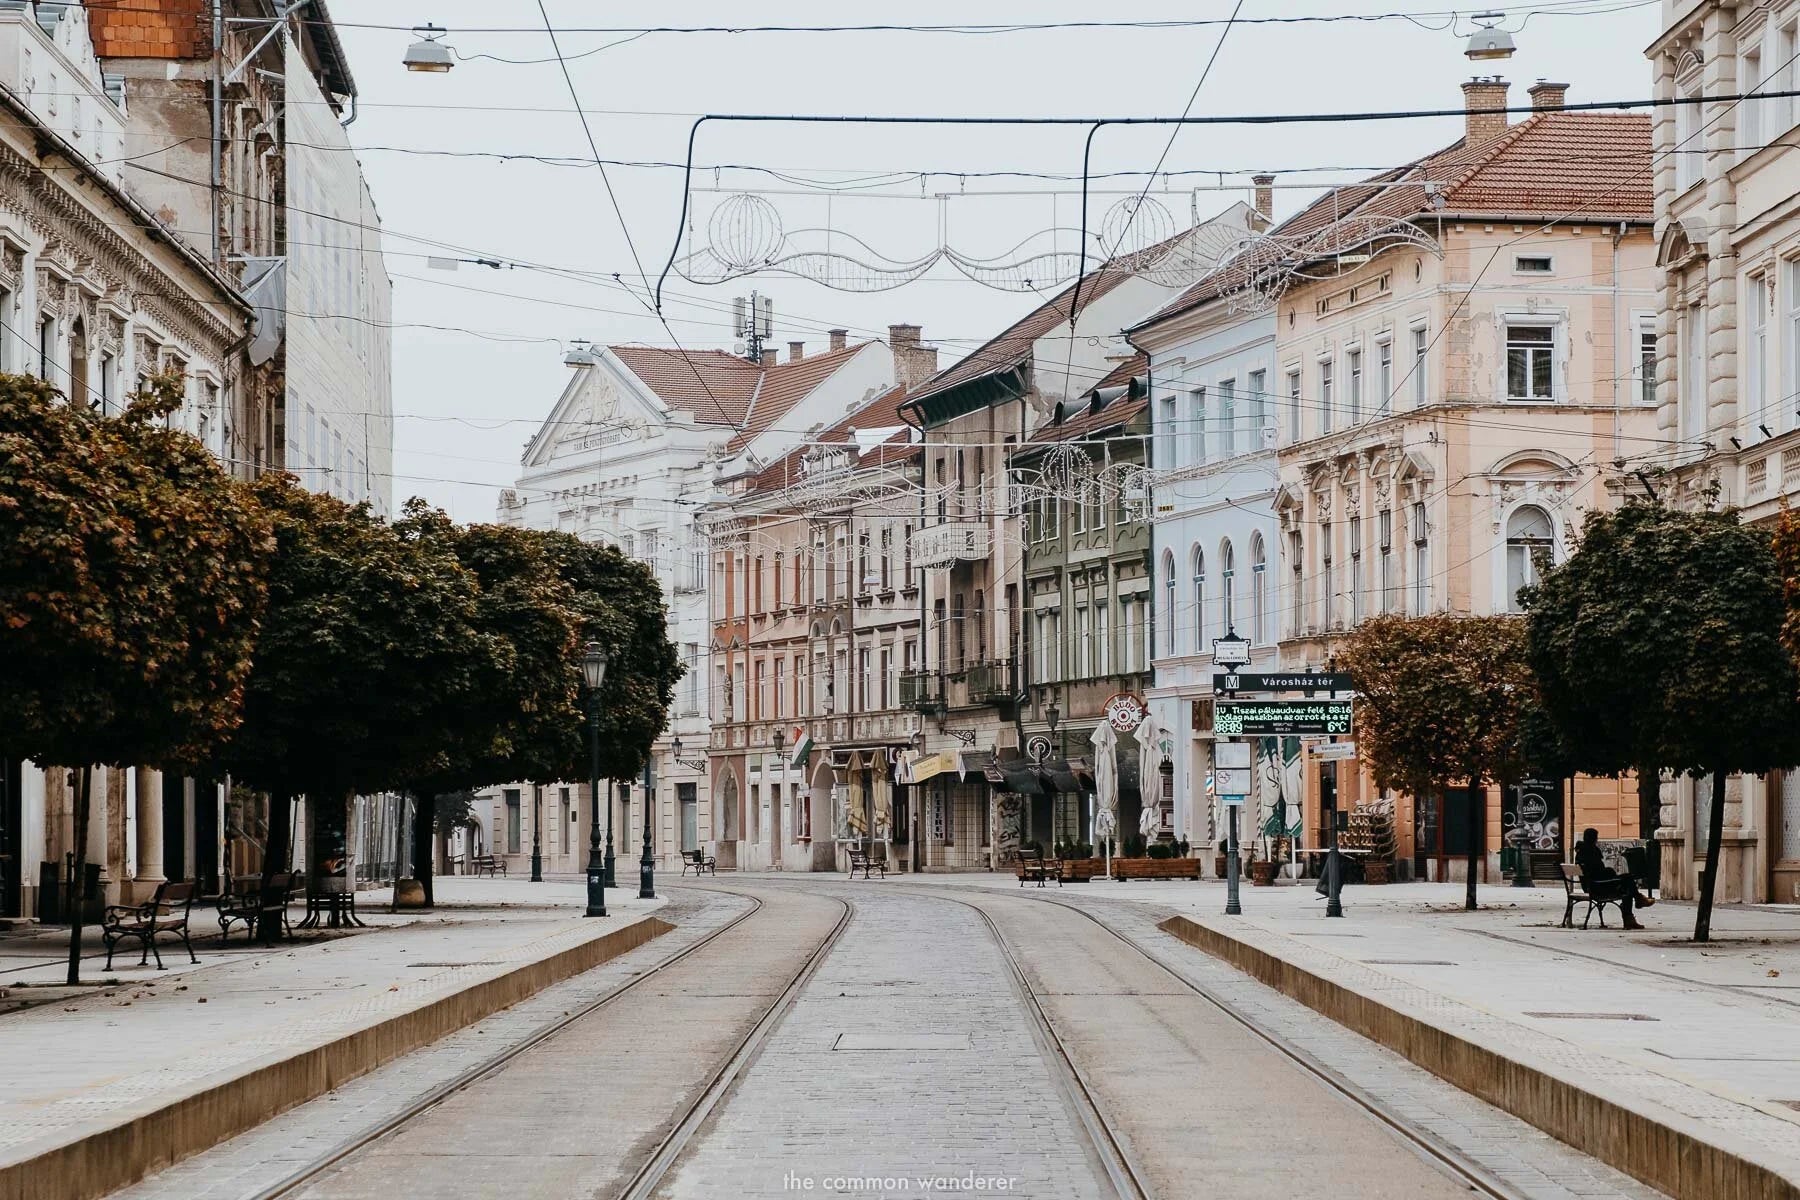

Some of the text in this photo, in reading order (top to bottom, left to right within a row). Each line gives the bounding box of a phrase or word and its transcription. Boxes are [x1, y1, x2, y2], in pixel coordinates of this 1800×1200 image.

[1261, 677, 1334, 686] Városház tér
[1113, 702, 1136, 712] BUDO
[1231, 706, 1257, 714] Tiszai
[1258, 706, 1306, 715] pályaudvar
[1307, 706, 1325, 714] felé
[1111, 718, 1136, 730] SPORT
